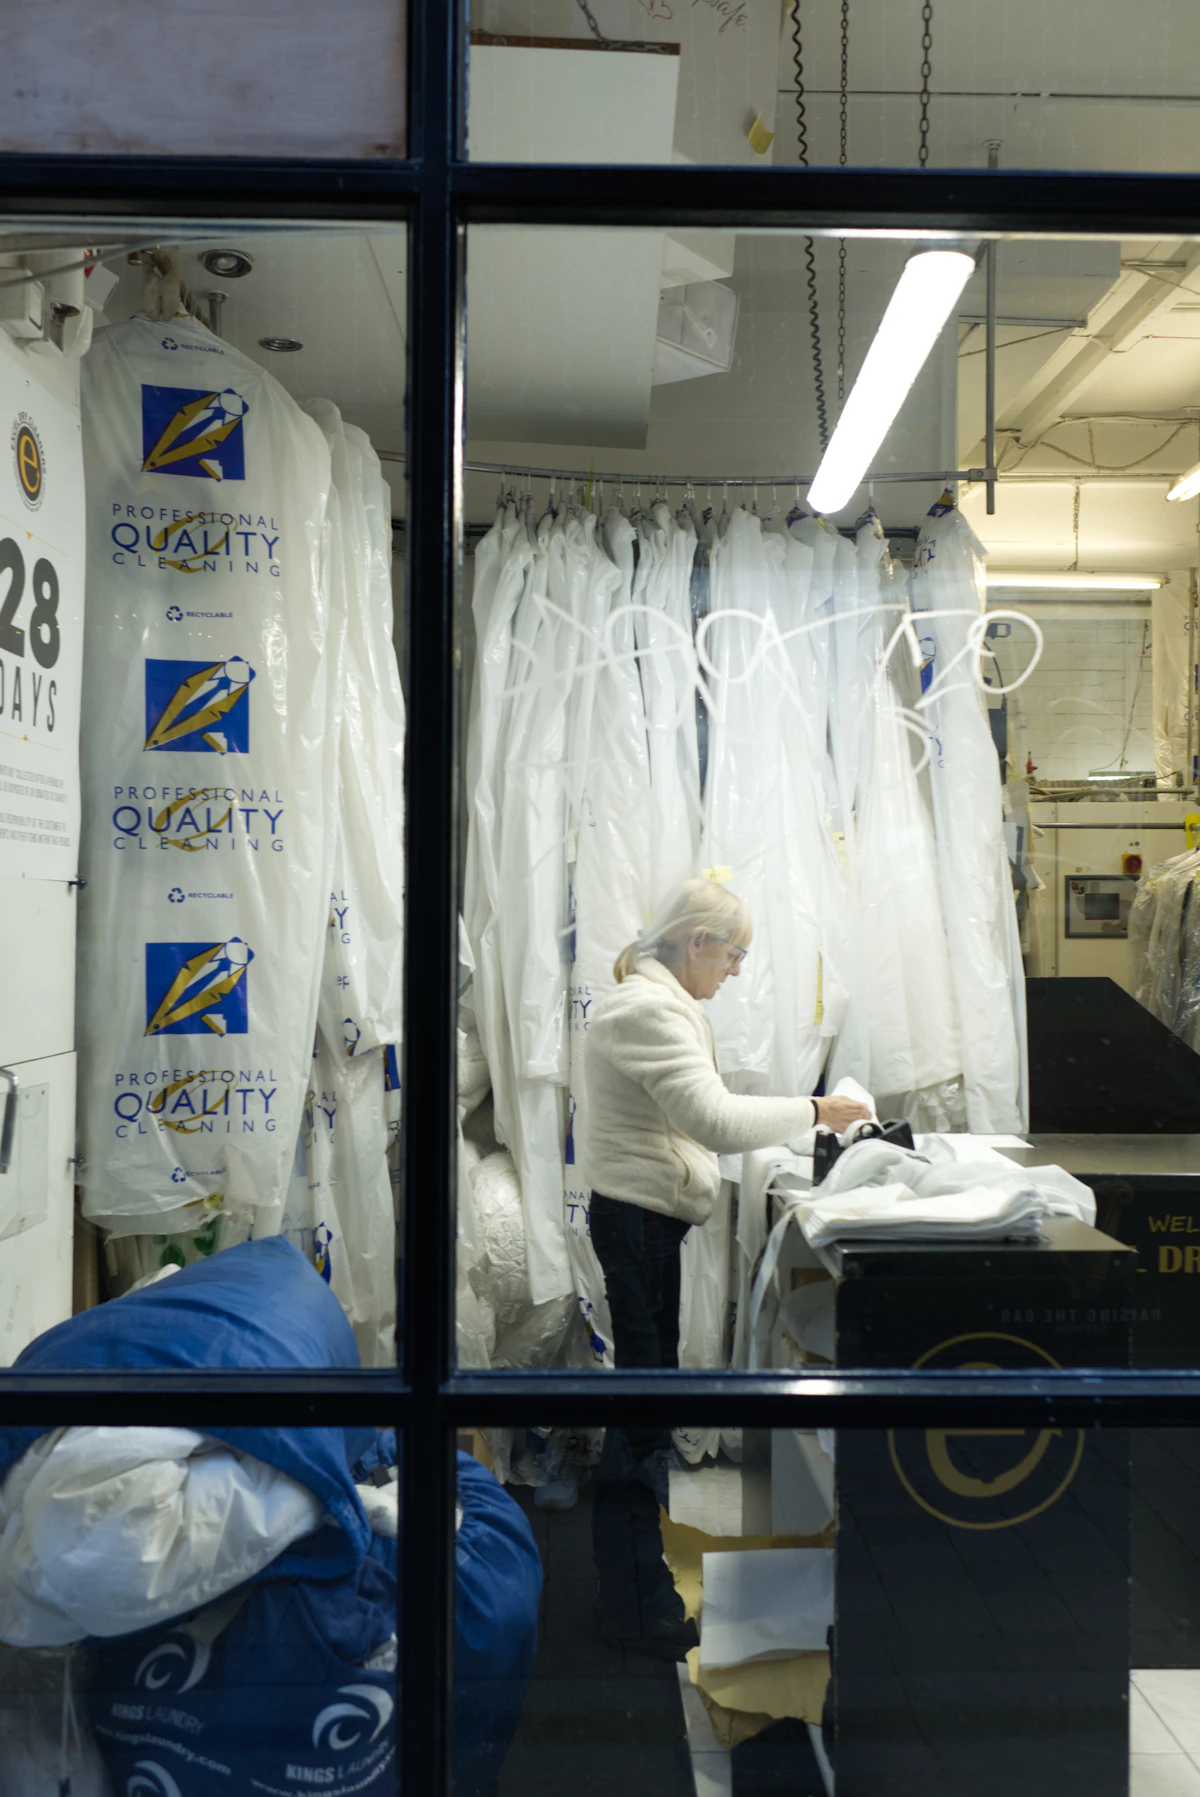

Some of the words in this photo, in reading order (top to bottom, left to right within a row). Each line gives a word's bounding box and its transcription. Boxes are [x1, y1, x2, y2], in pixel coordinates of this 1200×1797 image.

[180, 343, 225, 355] RECYCLABLE
[112, 503, 279, 531] PROFESSIONAL
[111, 522, 280, 559] QUALITY
[112, 552, 280, 577] CLEANING
[0, 537, 60, 669] 28
[186, 611, 233, 619] RECYCLABLE
[113, 786, 284, 803] PROFESSIONAL
[112, 806, 284, 837] QUALITY
[113, 837, 284, 852] CLEANING
[188, 892, 234, 900] RECYCLABLE
[115, 1069, 277, 1086] PROFESSIONAL
[114, 1088, 277, 1122] QUALITY
[115, 1119, 276, 1138] CLEANING
[285, 1763, 335, 1785] KINGS
